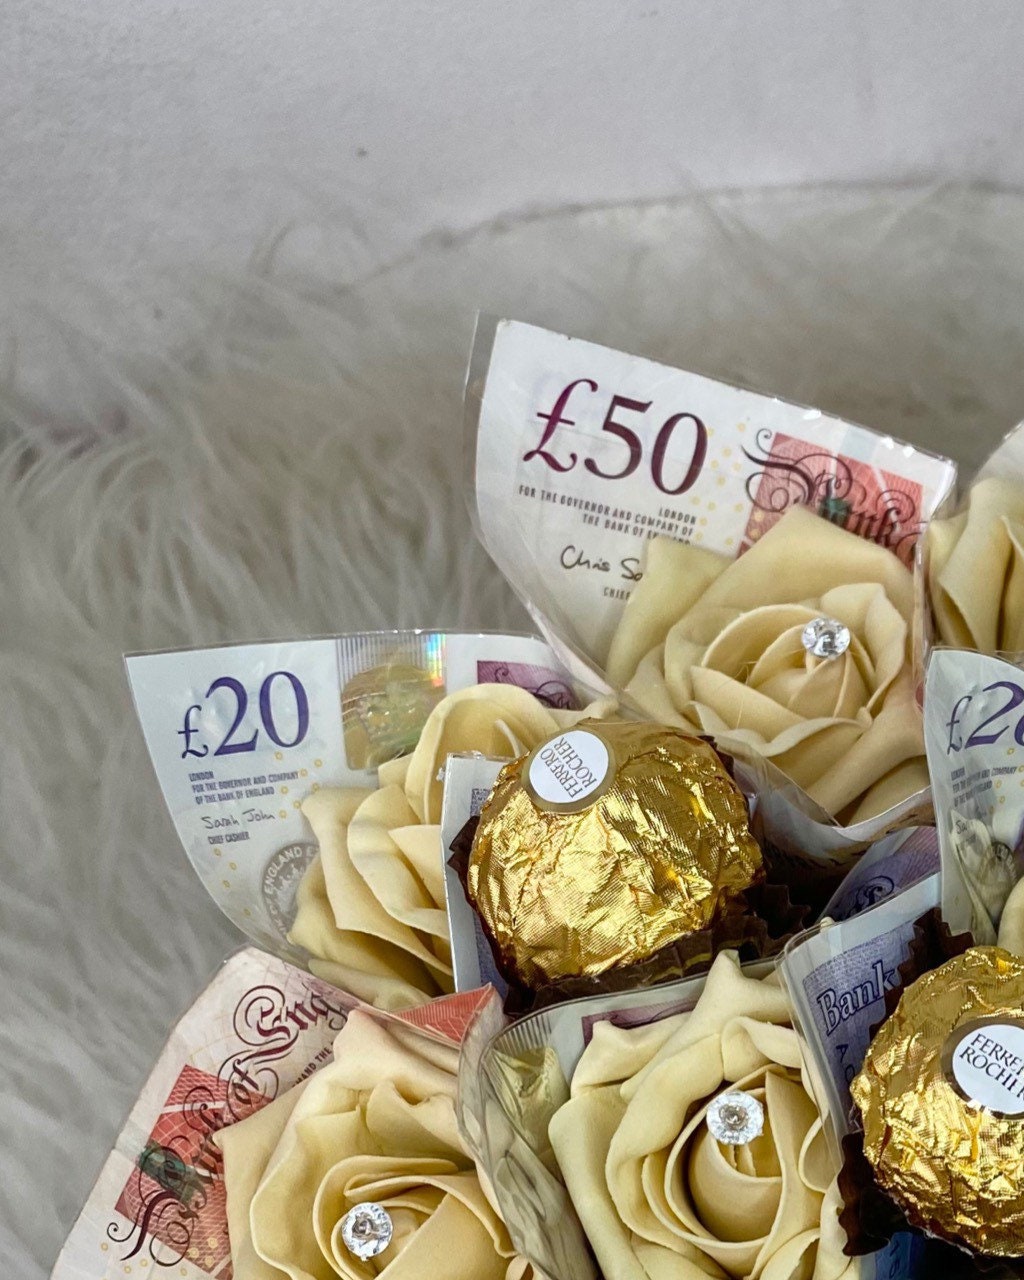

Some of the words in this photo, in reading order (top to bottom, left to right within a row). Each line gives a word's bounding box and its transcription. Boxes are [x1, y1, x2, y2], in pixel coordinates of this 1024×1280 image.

[522, 377, 709, 496] £50
[519, 485, 536, 498] FOR
[540, 490, 557, 503] THE
[560, 495, 610, 516] GOVERNOR
[612, 508, 632, 522] AND
[635, 514, 679, 533] COMPANY
[682, 525, 694, 537] OF
[583, 513, 600, 527] THE
[605, 521, 630, 534] BANK
[633, 526, 645, 537] OF
[659, 507, 697, 526] LONDON
[176, 670, 310, 759] £20
[188, 771, 215, 782] LONDON
[540, 747, 583, 799] FERRERO
[554, 736, 598, 788] ROCHER
[192, 783, 205, 793] FOR
[205, 781, 218, 791] THE
[219, 778, 253, 790] GOVERNOR
[253, 775, 267, 785] AND
[268, 771, 300, 783] COMPANY
[195, 795, 205, 805] OF
[204, 792, 218, 804] THE
[218, 791, 236, 802] BANK
[236, 790, 245, 800] OF
[245, 786, 275, 798] ENGLAND
[208, 834, 225, 845] CHIEF
[225, 831, 251, 844] CASHIER
[816, 959, 897, 1037] Bank
